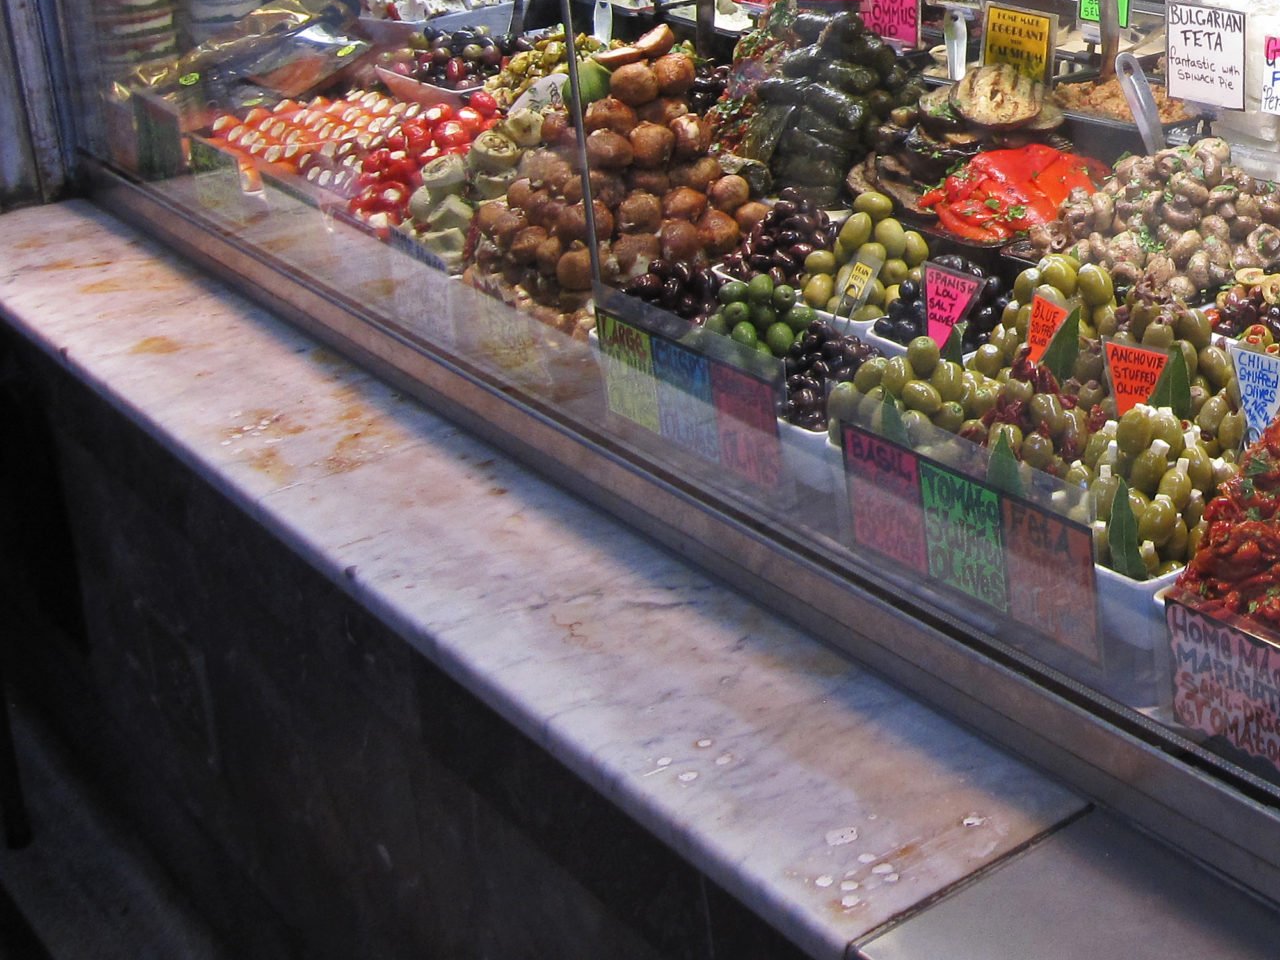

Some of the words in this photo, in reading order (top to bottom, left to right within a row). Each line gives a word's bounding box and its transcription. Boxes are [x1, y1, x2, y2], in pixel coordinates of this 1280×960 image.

[1168, 3, 1243, 33] BULGARIAN
[990, 21, 1044, 42] EGGPLANT
[1180, 29, 1223, 53] FETA
[1169, 45, 1216, 73] fantastic
[1177, 69, 1215, 85] SPINACH
[1217, 75, 1235, 91] Pie
[927, 270, 977, 296] SPANISH
[934, 286, 959, 301] LOW
[928, 297, 956, 314] SALT
[1032, 299, 1060, 327] BLUE
[928, 312, 956, 327] OLIVES
[1110, 346, 1165, 370] ANCHOVIE
[1112, 365, 1157, 386] STUFFED
[1116, 382, 1151, 400] OLIVES
